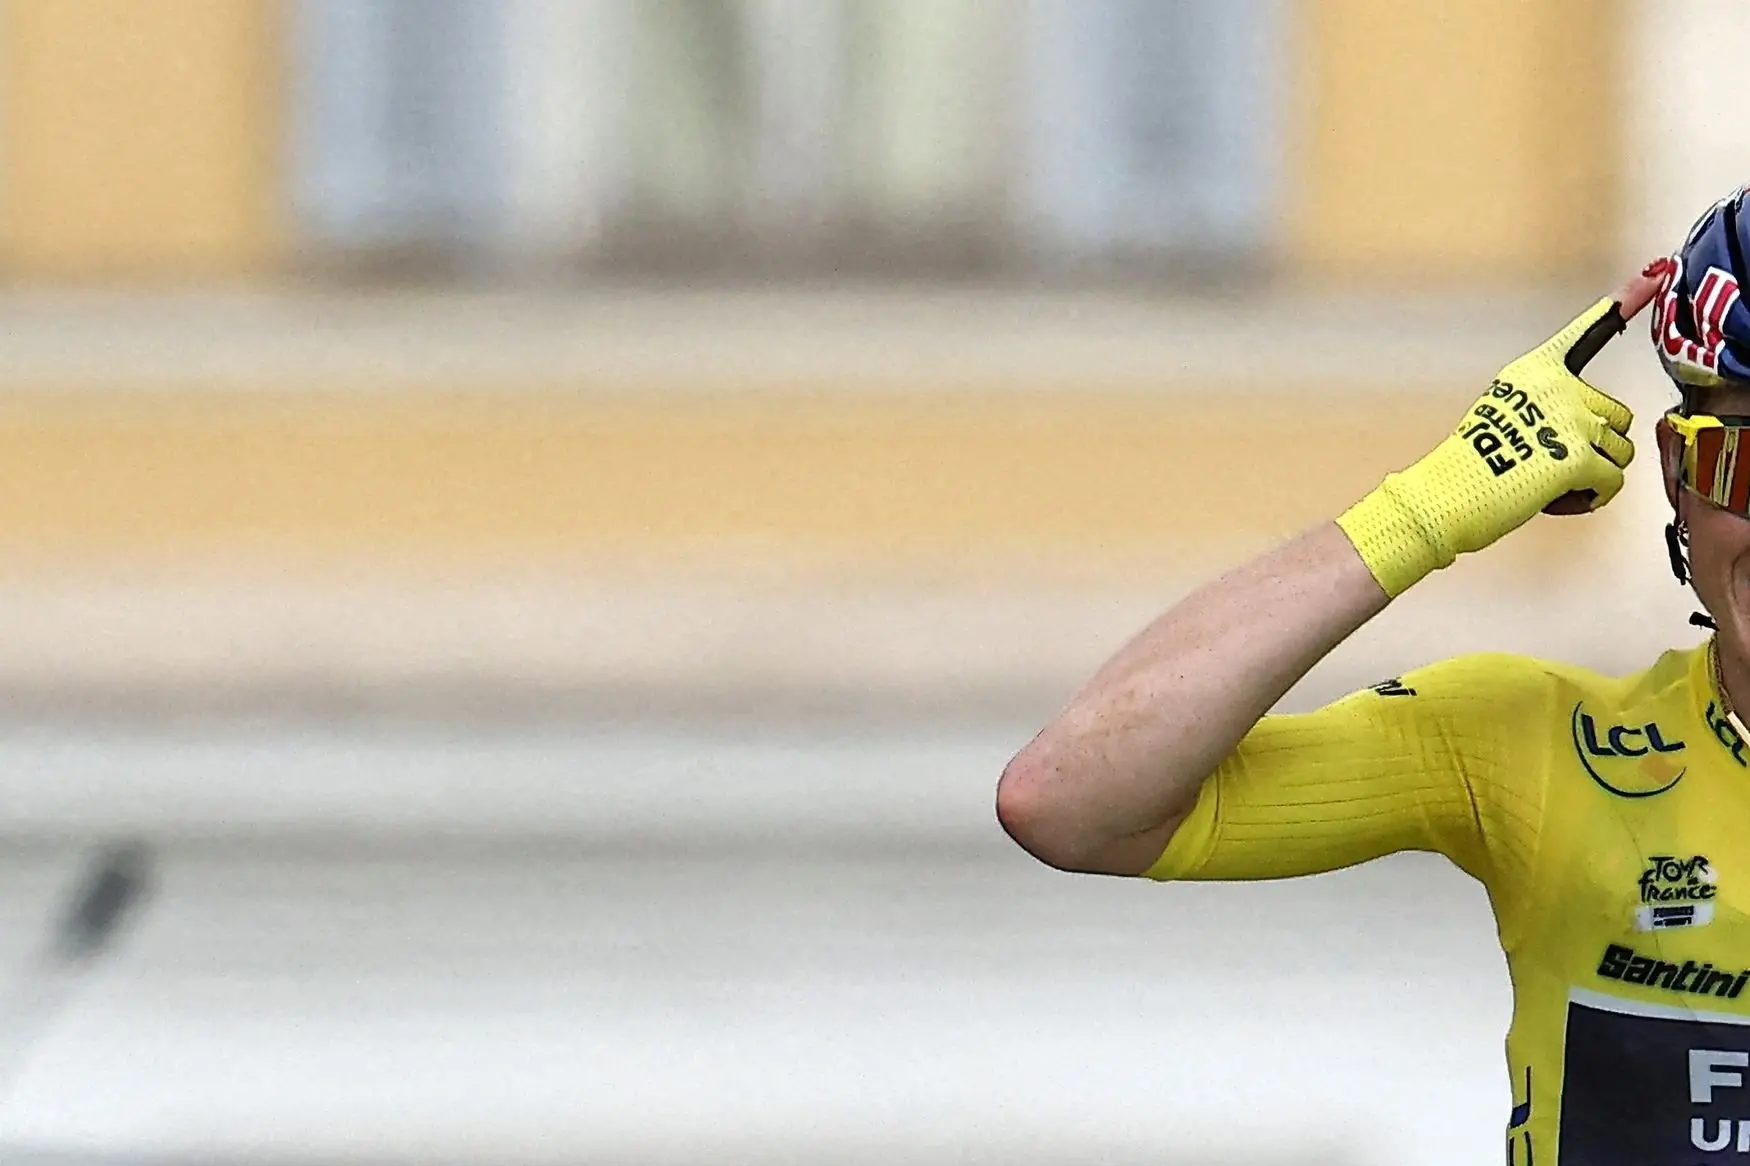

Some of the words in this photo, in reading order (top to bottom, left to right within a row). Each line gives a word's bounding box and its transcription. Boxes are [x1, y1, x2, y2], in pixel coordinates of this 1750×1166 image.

[1462, 422, 1517, 477] FDJ
[1474, 404, 1533, 461] UNITED
[1581, 713, 1687, 757] LCL
